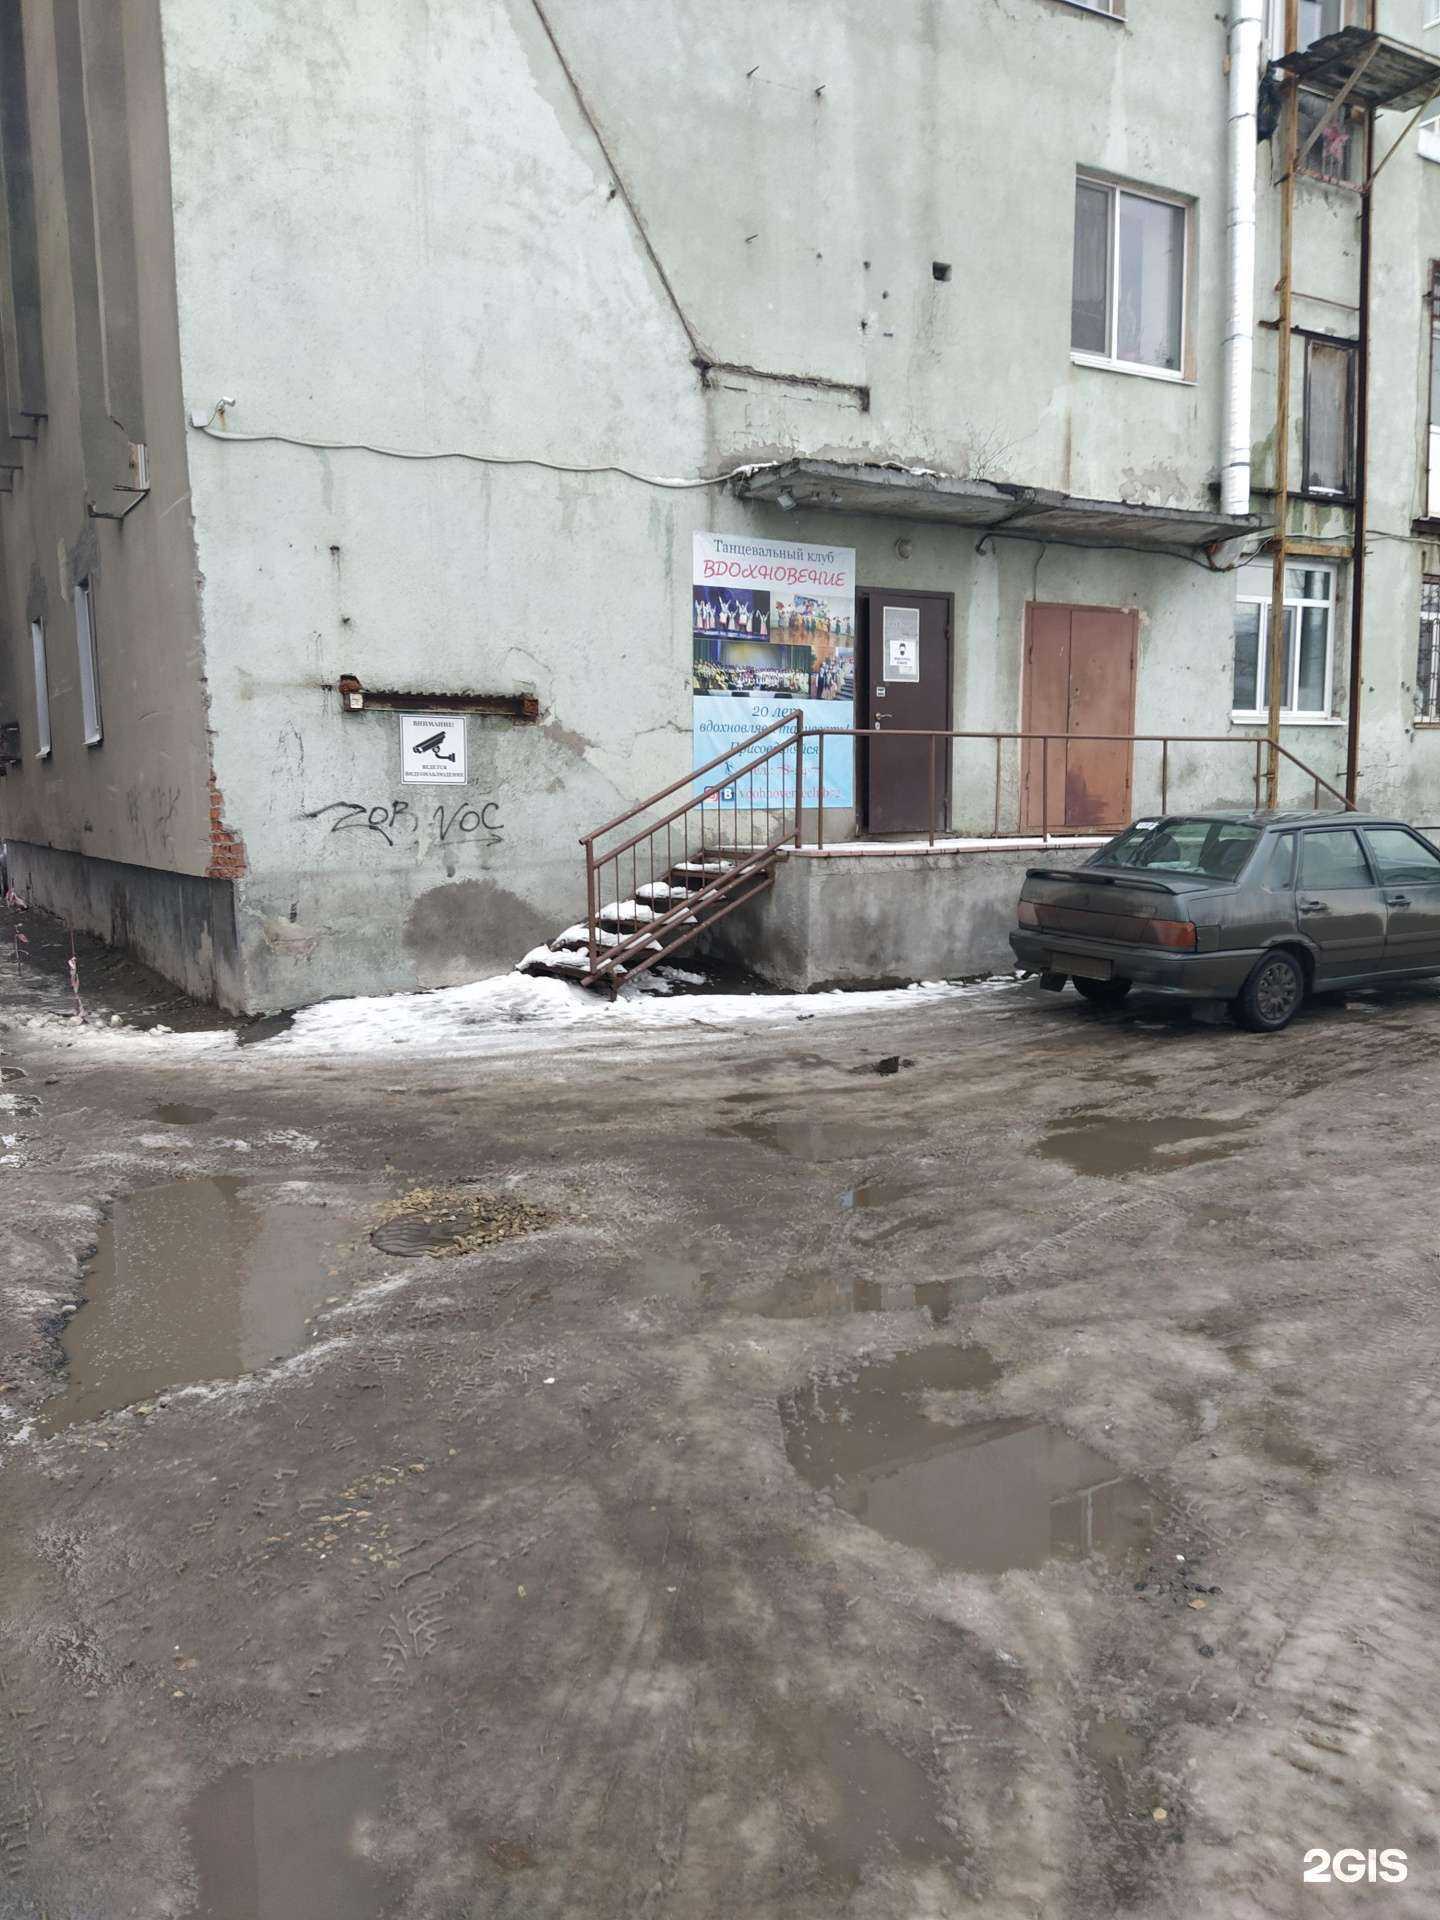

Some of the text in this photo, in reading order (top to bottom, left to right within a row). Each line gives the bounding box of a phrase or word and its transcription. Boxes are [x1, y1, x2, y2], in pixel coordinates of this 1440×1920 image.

[713, 539, 835, 566] Танцевальный клуб
[703, 559, 847, 586] ВДОХНОВЕНИЕ
[752, 705, 798, 718] 20 ле
[699, 719, 775, 735] вдохновляе
